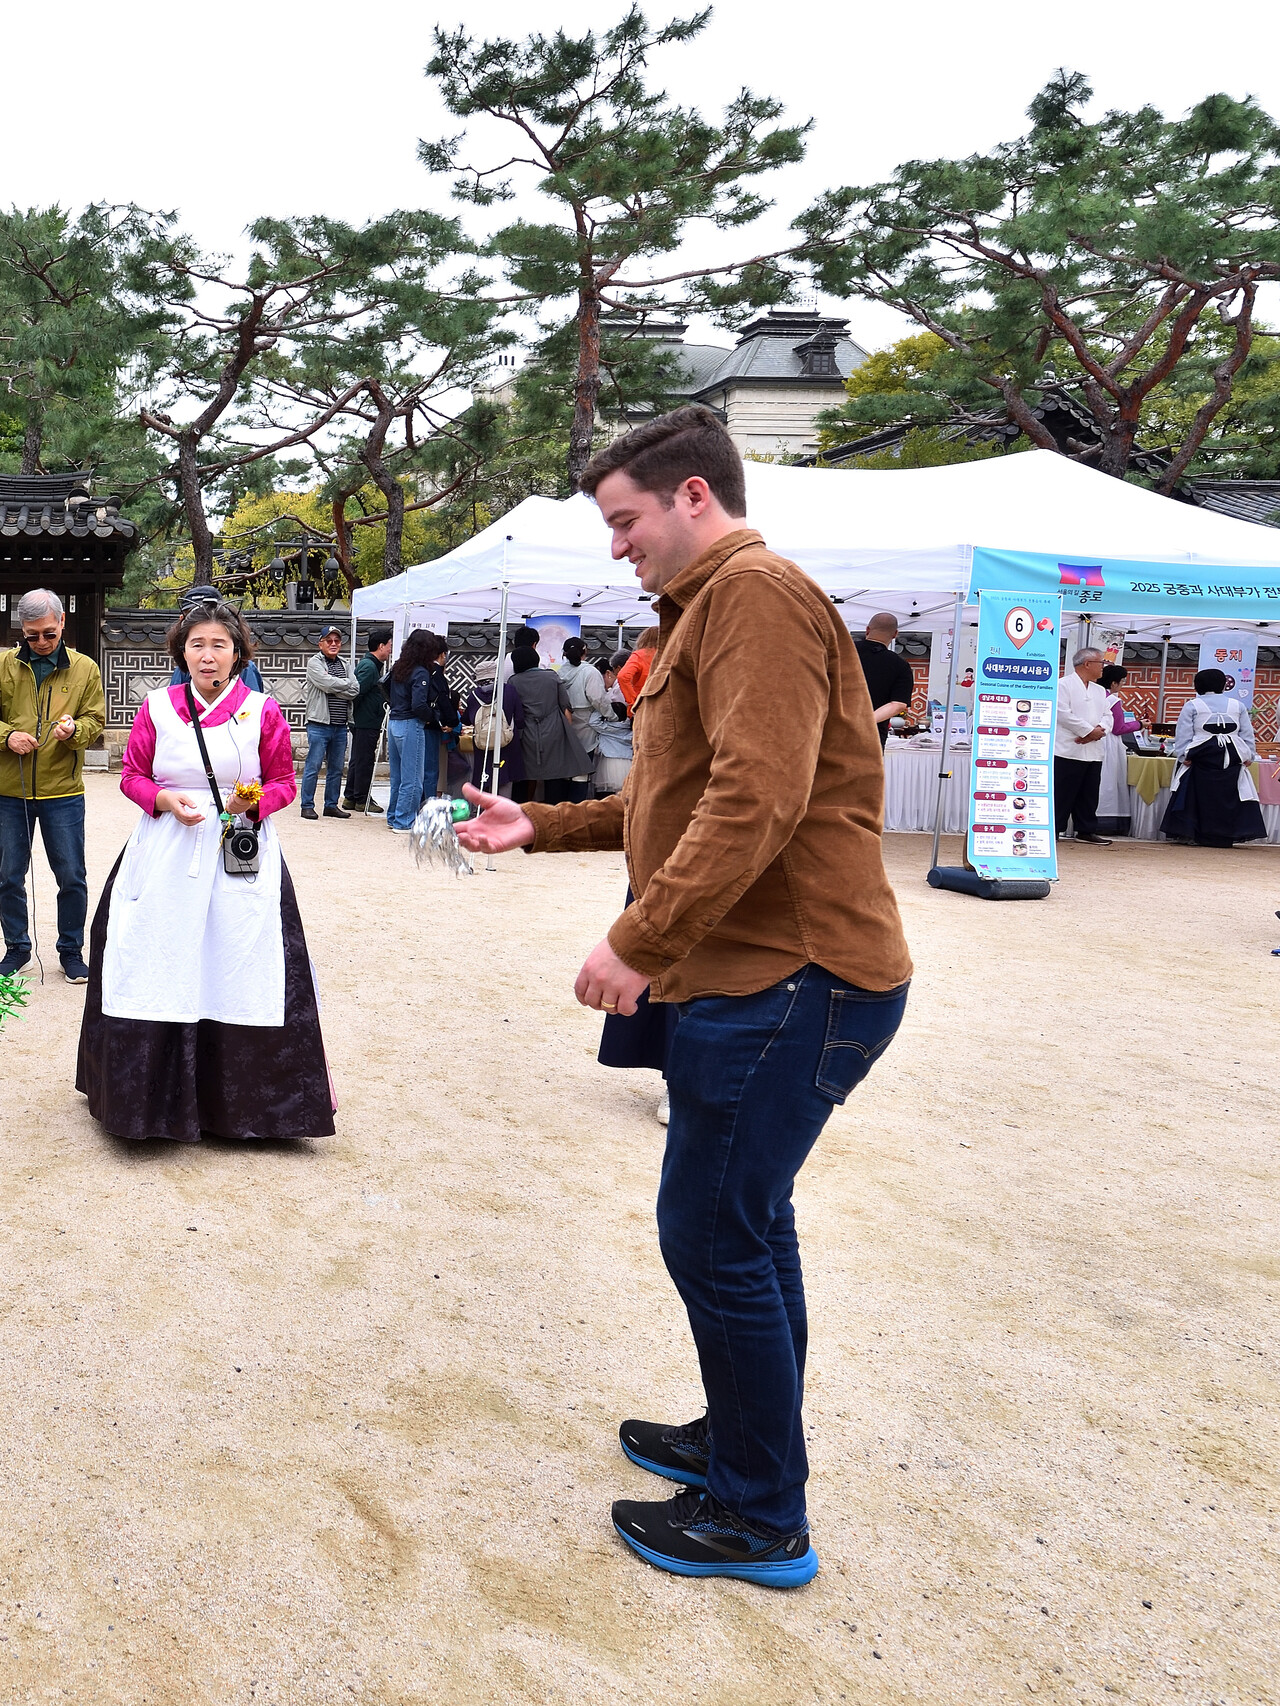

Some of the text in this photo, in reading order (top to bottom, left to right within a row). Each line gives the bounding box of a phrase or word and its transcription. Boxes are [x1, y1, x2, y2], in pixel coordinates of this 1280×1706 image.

[1079, 589, 1103, 604] 종로
[1130, 581, 1161, 593] 2025
[1163, 582, 1204, 597] 궁중과
[1207, 584, 1261, 598] 사대부가
[1015, 617, 1024, 633] 6
[1214, 648, 1243, 663] 동지
